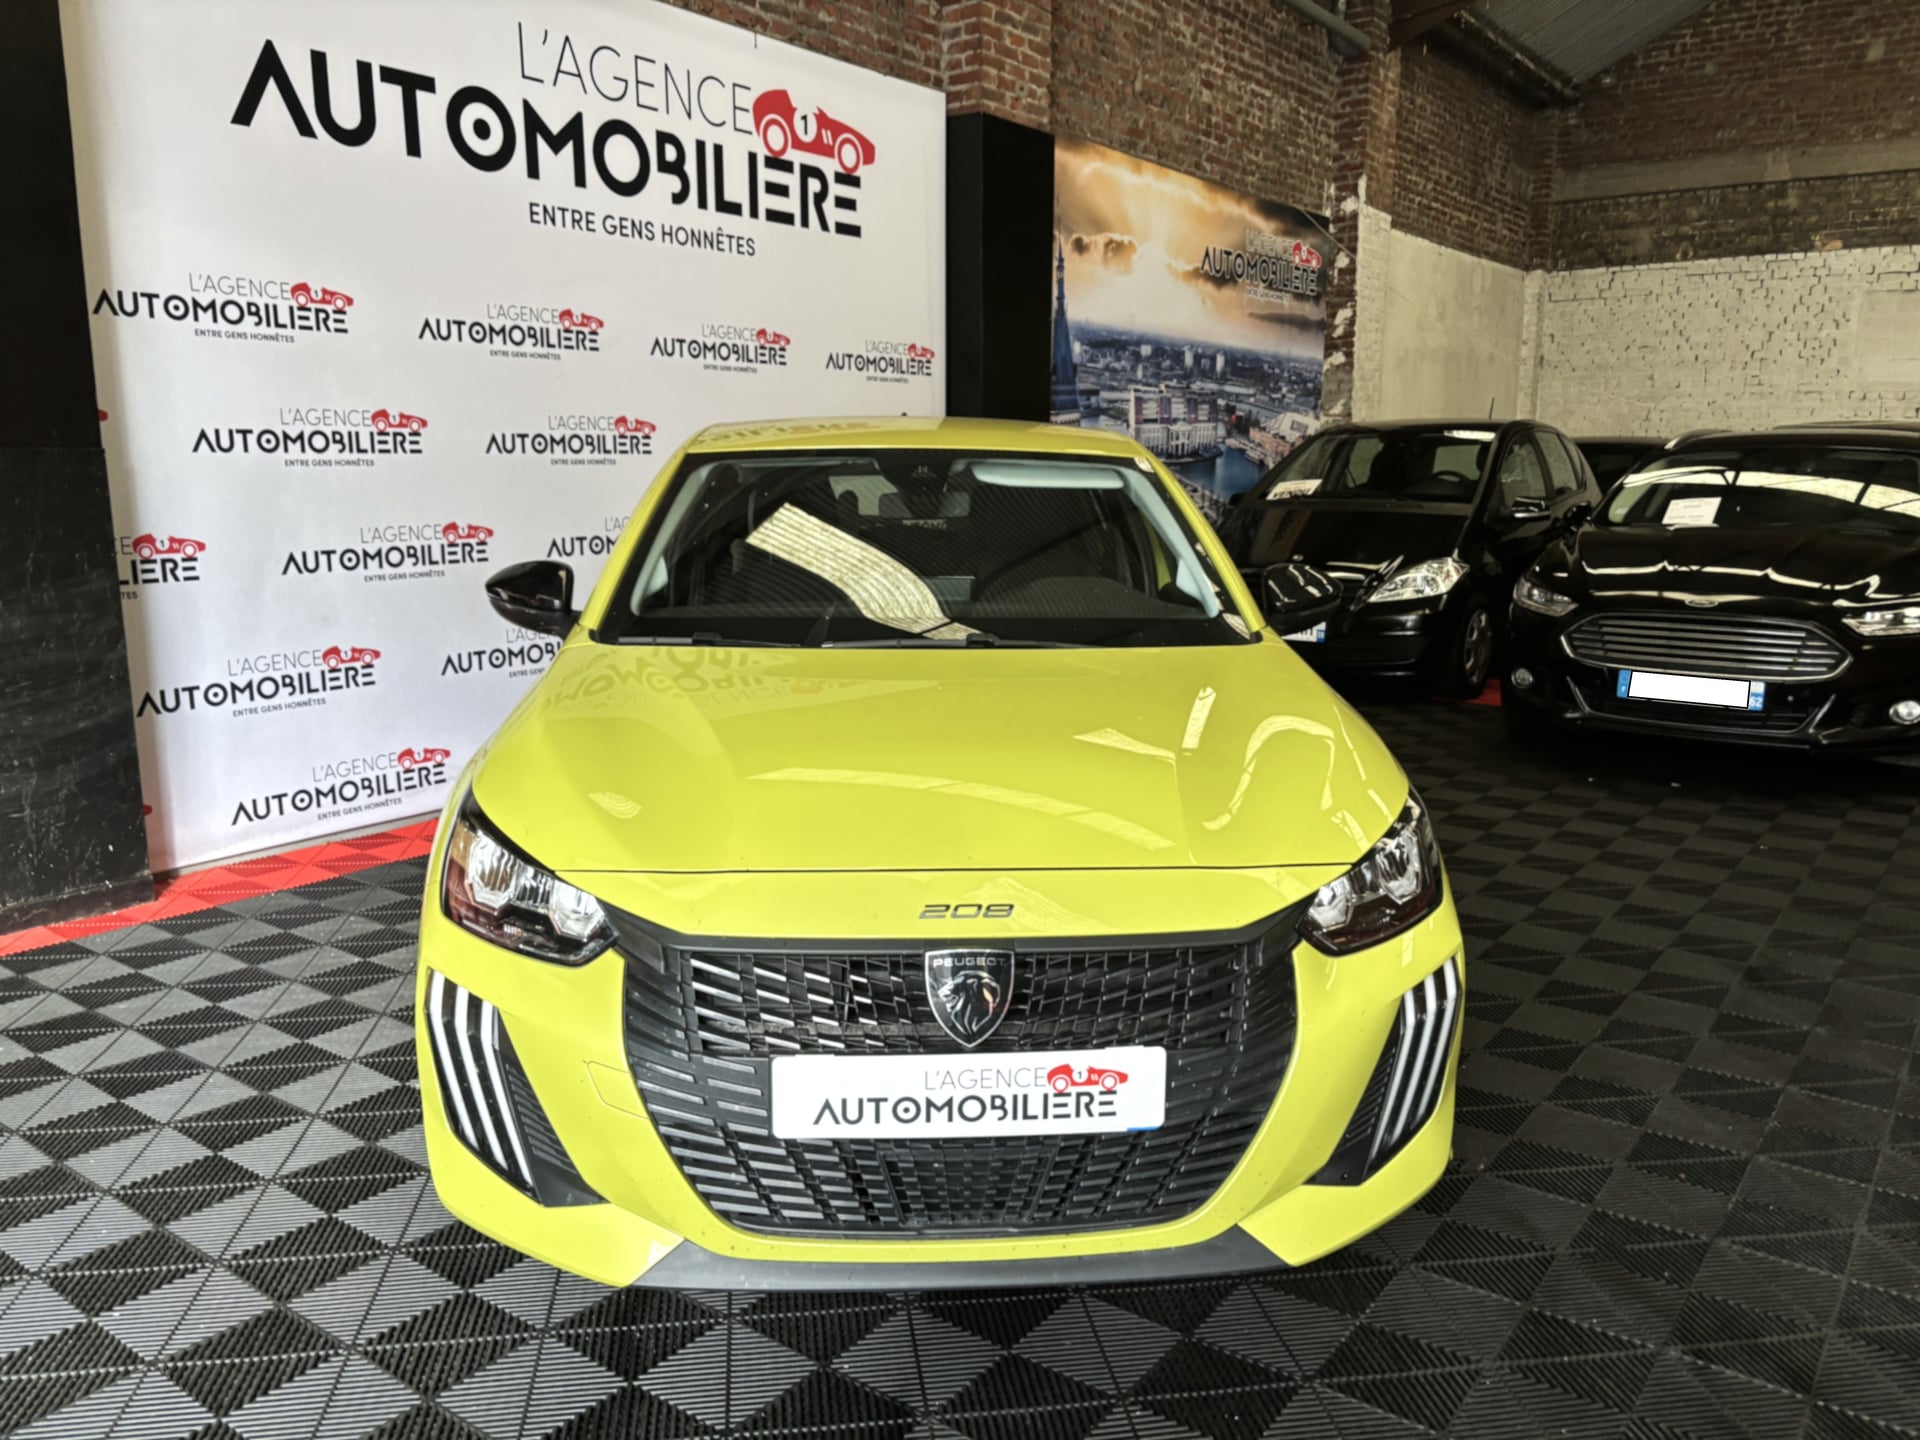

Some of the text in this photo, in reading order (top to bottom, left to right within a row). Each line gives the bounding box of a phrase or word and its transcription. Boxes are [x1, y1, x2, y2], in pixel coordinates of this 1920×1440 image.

[518, 22, 753, 136] L'AGENCE
[799, 113, 810, 137] 1
[529, 202, 756, 257] ENTRE GENS HONNÊTES
[189, 273, 291, 300] L'AGENCE
[486, 303, 558, 325] L'AGENCE
[194, 328, 295, 343] ENTRE GENS HONNÊTES
[701, 323, 756, 342] L'AGENCE
[490, 349, 510, 357] ENTRE
[511, 350, 528, 358] GENS
[865, 339, 908, 356] L'AGENCE
[280, 407, 372, 428] L'AGENCE
[547, 415, 615, 431] L'AGENCE
[284, 457, 375, 467] ENTRE GENS HONNÊTES
[360, 523, 443, 544] L'AGENCE
[363, 569, 446, 583] ENTRE GENS HONNÊTES
[227, 649, 322, 677] L'AGENCE
[509, 669, 528, 678] ENTRE
[232, 697, 326, 718] ENTRE GENS HONNÊTES
[312, 752, 397, 783] L'AGENCE
[317, 797, 403, 821] ENTRE GENS HONNÊTES
[918, 903, 1015, 919] 208
[933, 956, 1007, 969] PEUGEOT
[924, 1066, 1047, 1092] L'AGENCE
